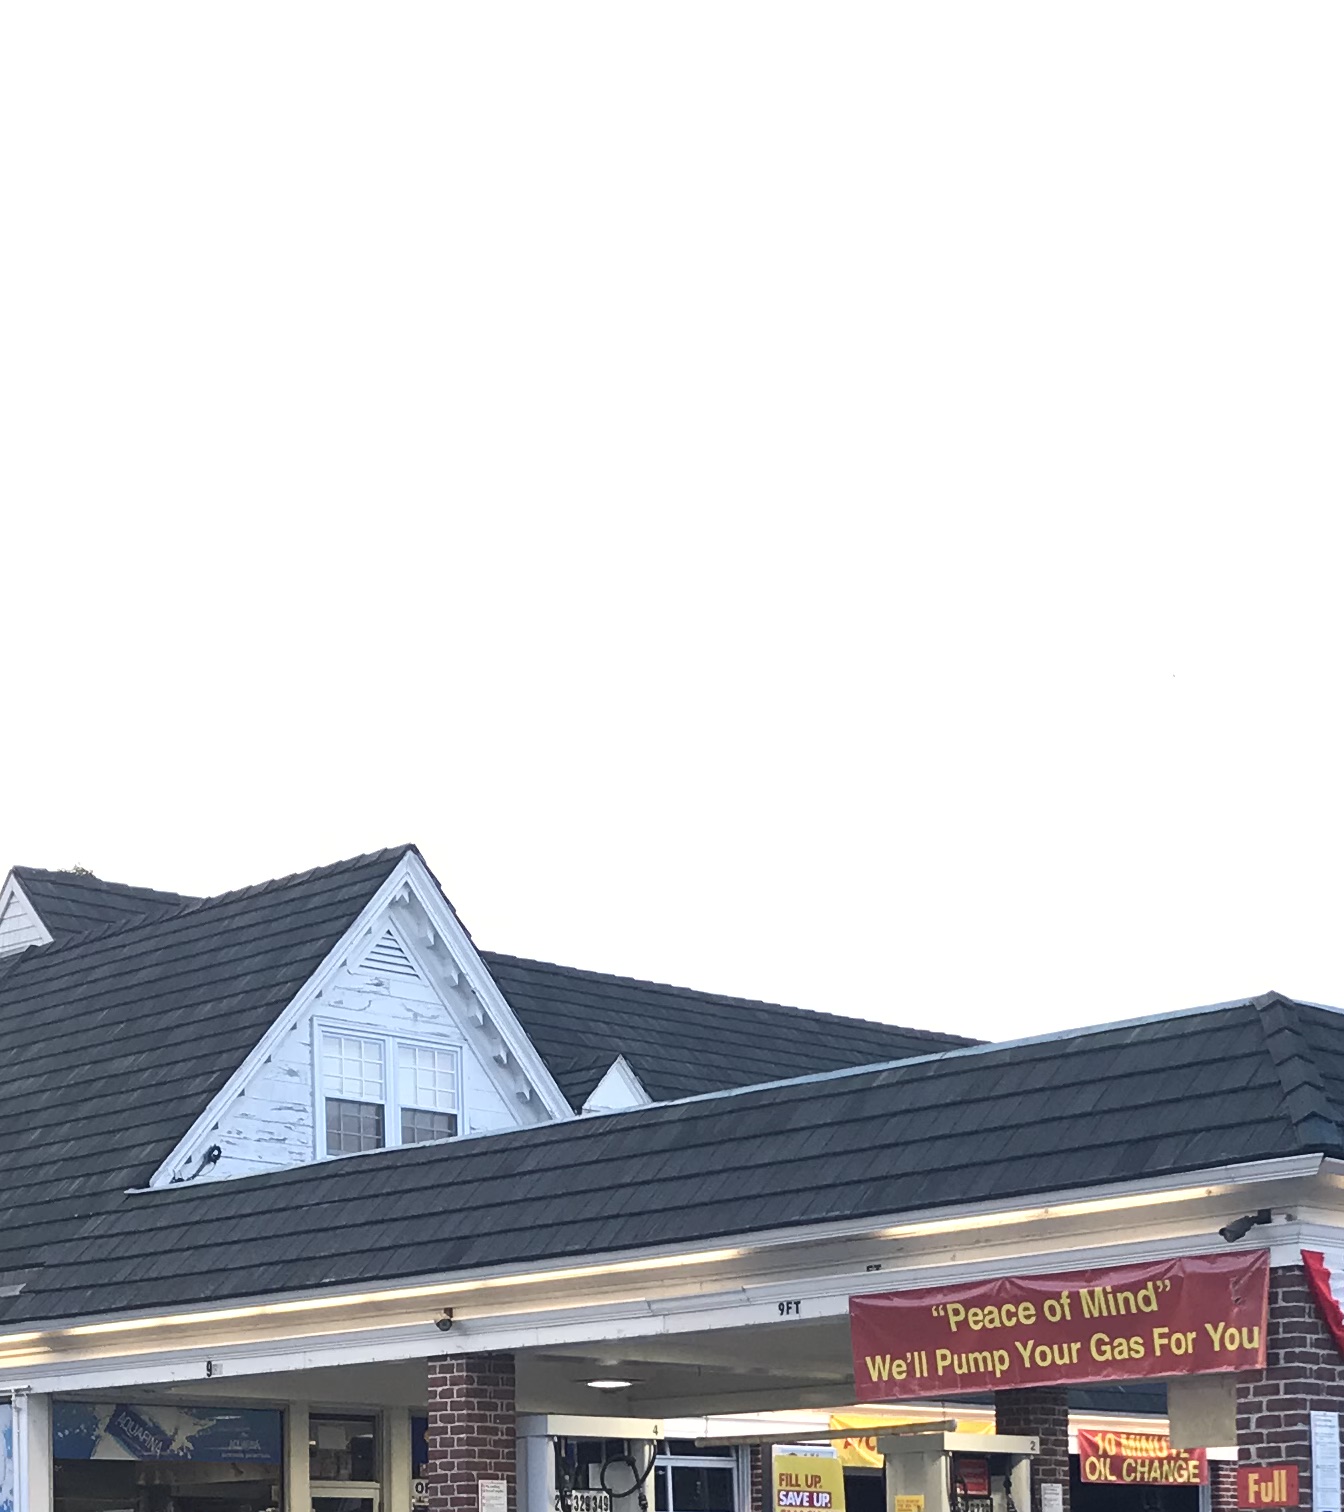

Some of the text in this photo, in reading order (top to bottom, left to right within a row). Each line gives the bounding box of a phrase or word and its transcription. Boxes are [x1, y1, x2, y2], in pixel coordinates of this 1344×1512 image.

[777, 1300, 801, 1316] 9FT
[1043, 1290, 1072, 1322] of
[865, 1321, 1260, 1382] We’ll Pump Your Gas For You
[116, 1411, 163, 1460] AQUAFINA
[652, 1424, 659, 1436] 4
[1029, 1440, 1036, 1451] 2
[1096, 1432, 1116, 1456] 10
[778, 1472, 823, 1489] FILL UP.
[1084, 1456, 1201, 1483] OIL CHANGE
[1247, 1469, 1288, 1504] Full
[779, 1490, 831, 1508] SAVE UP.
